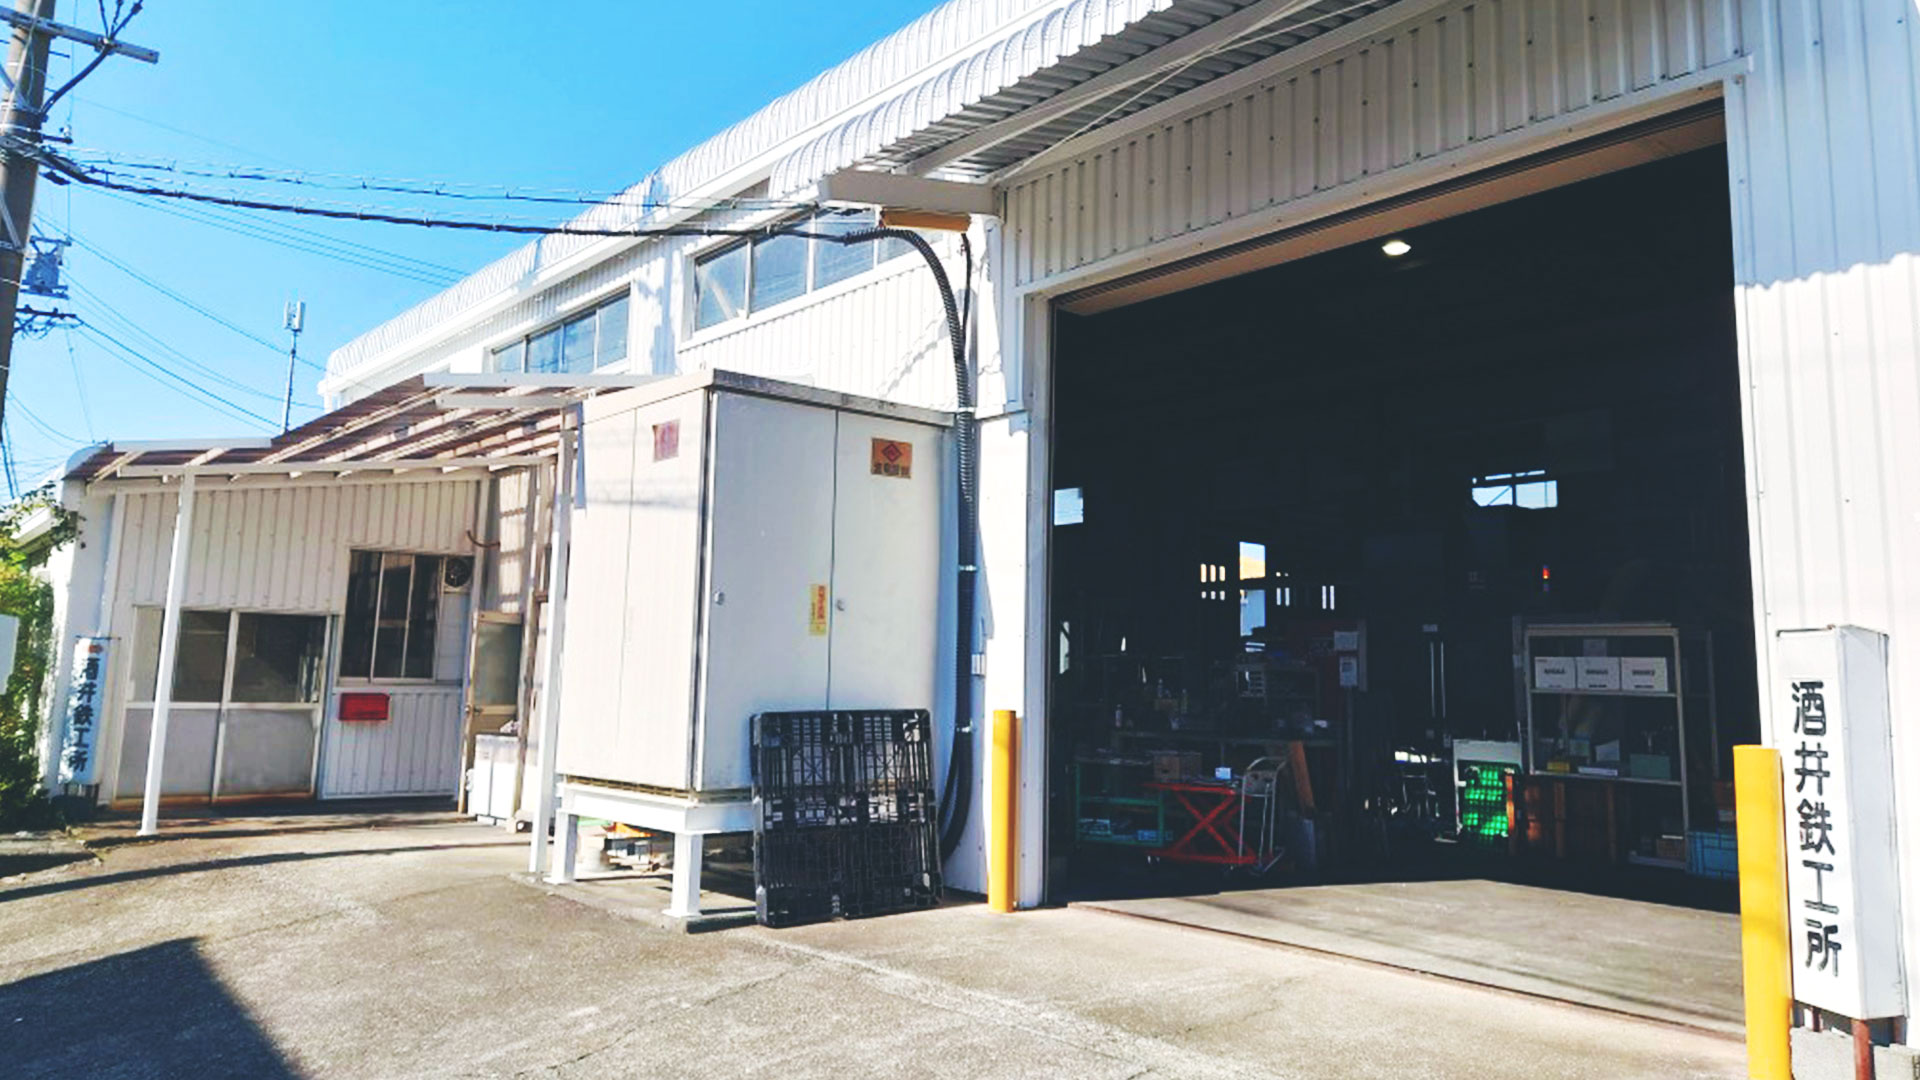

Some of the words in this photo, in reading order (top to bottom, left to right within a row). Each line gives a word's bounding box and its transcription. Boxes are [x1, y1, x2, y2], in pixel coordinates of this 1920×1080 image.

[68, 657, 101, 772] 酒井鉄工所
[1791, 681, 1842, 977] 酒井鉄工所
